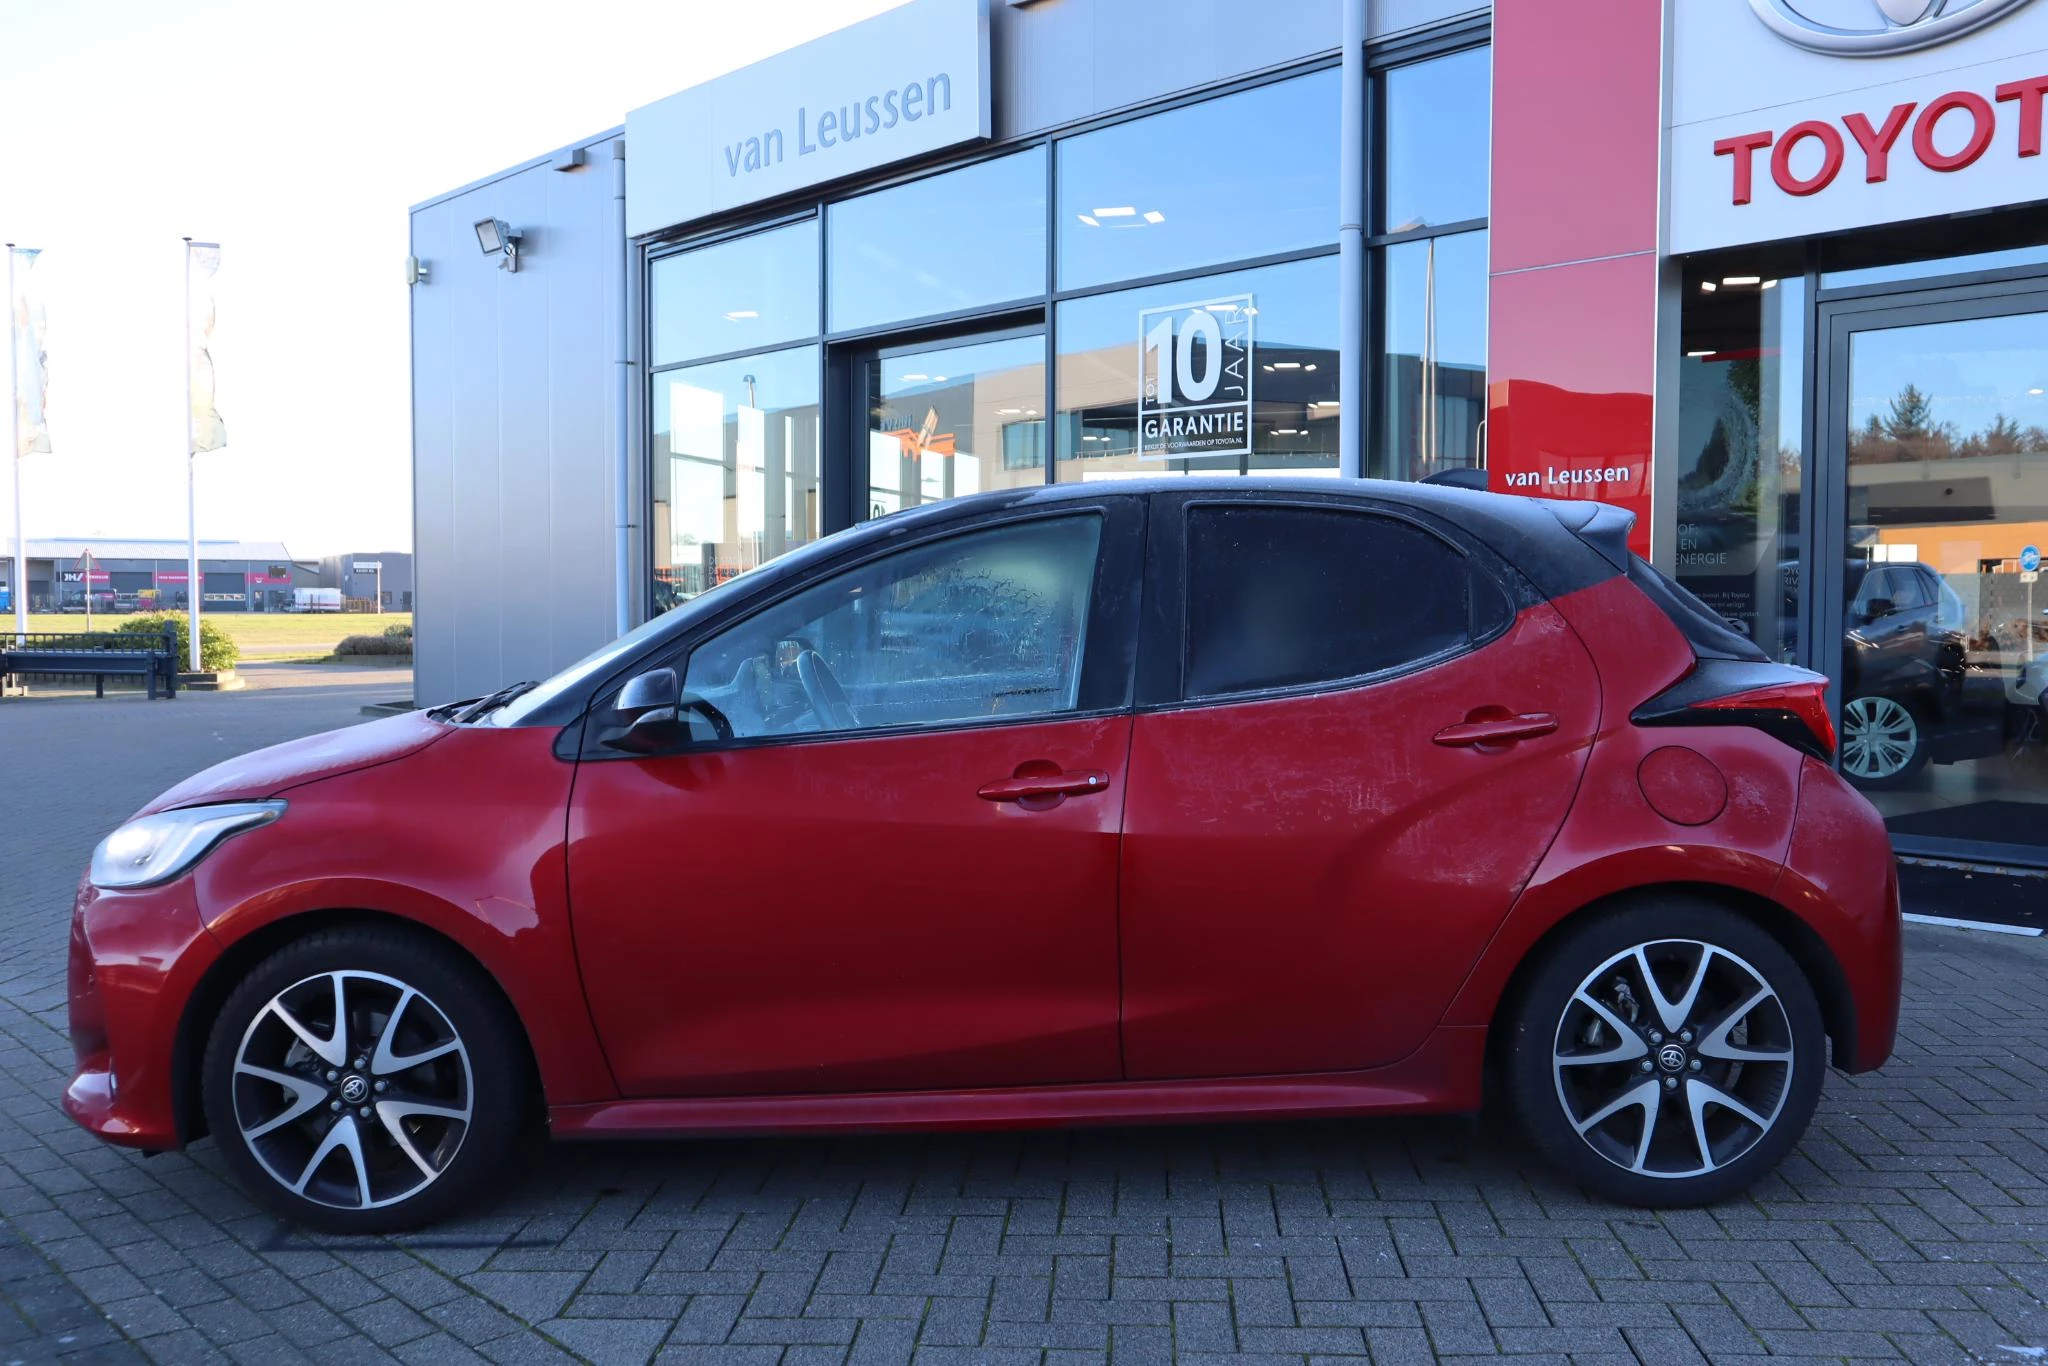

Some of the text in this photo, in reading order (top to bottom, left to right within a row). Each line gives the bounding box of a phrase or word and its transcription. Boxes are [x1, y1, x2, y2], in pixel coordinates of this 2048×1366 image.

[724, 72, 951, 177] van Leussen
[1714, 75, 2048, 206] TOYOT
[1146, 310, 1222, 404] 10
[1224, 306, 1244, 397] JAAR
[1145, 375, 1154, 405] TOT
[1145, 411, 1244, 438] GARANTIE
[1505, 466, 1629, 487] van Leussen
[1681, 539, 1697, 550] EN
